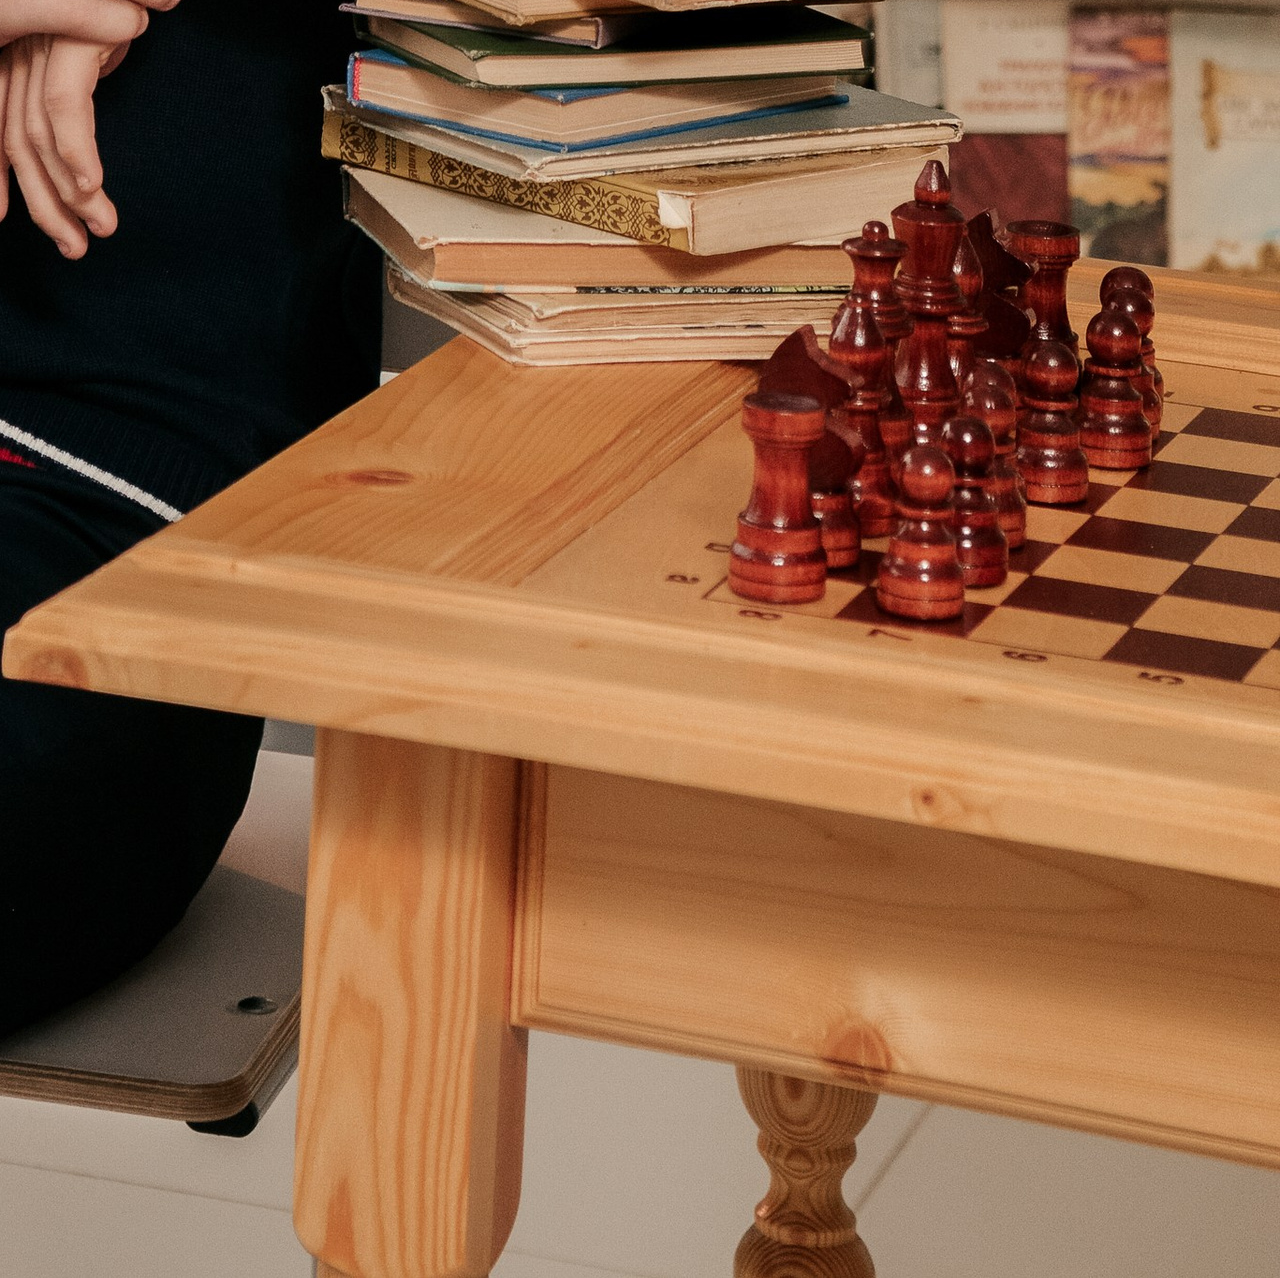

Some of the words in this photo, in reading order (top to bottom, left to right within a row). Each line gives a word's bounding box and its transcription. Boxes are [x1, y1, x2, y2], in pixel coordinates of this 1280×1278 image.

[738, 609, 782, 621] 8
[867, 628, 913, 642] 7
[1136, 671, 1185, 686] 5
